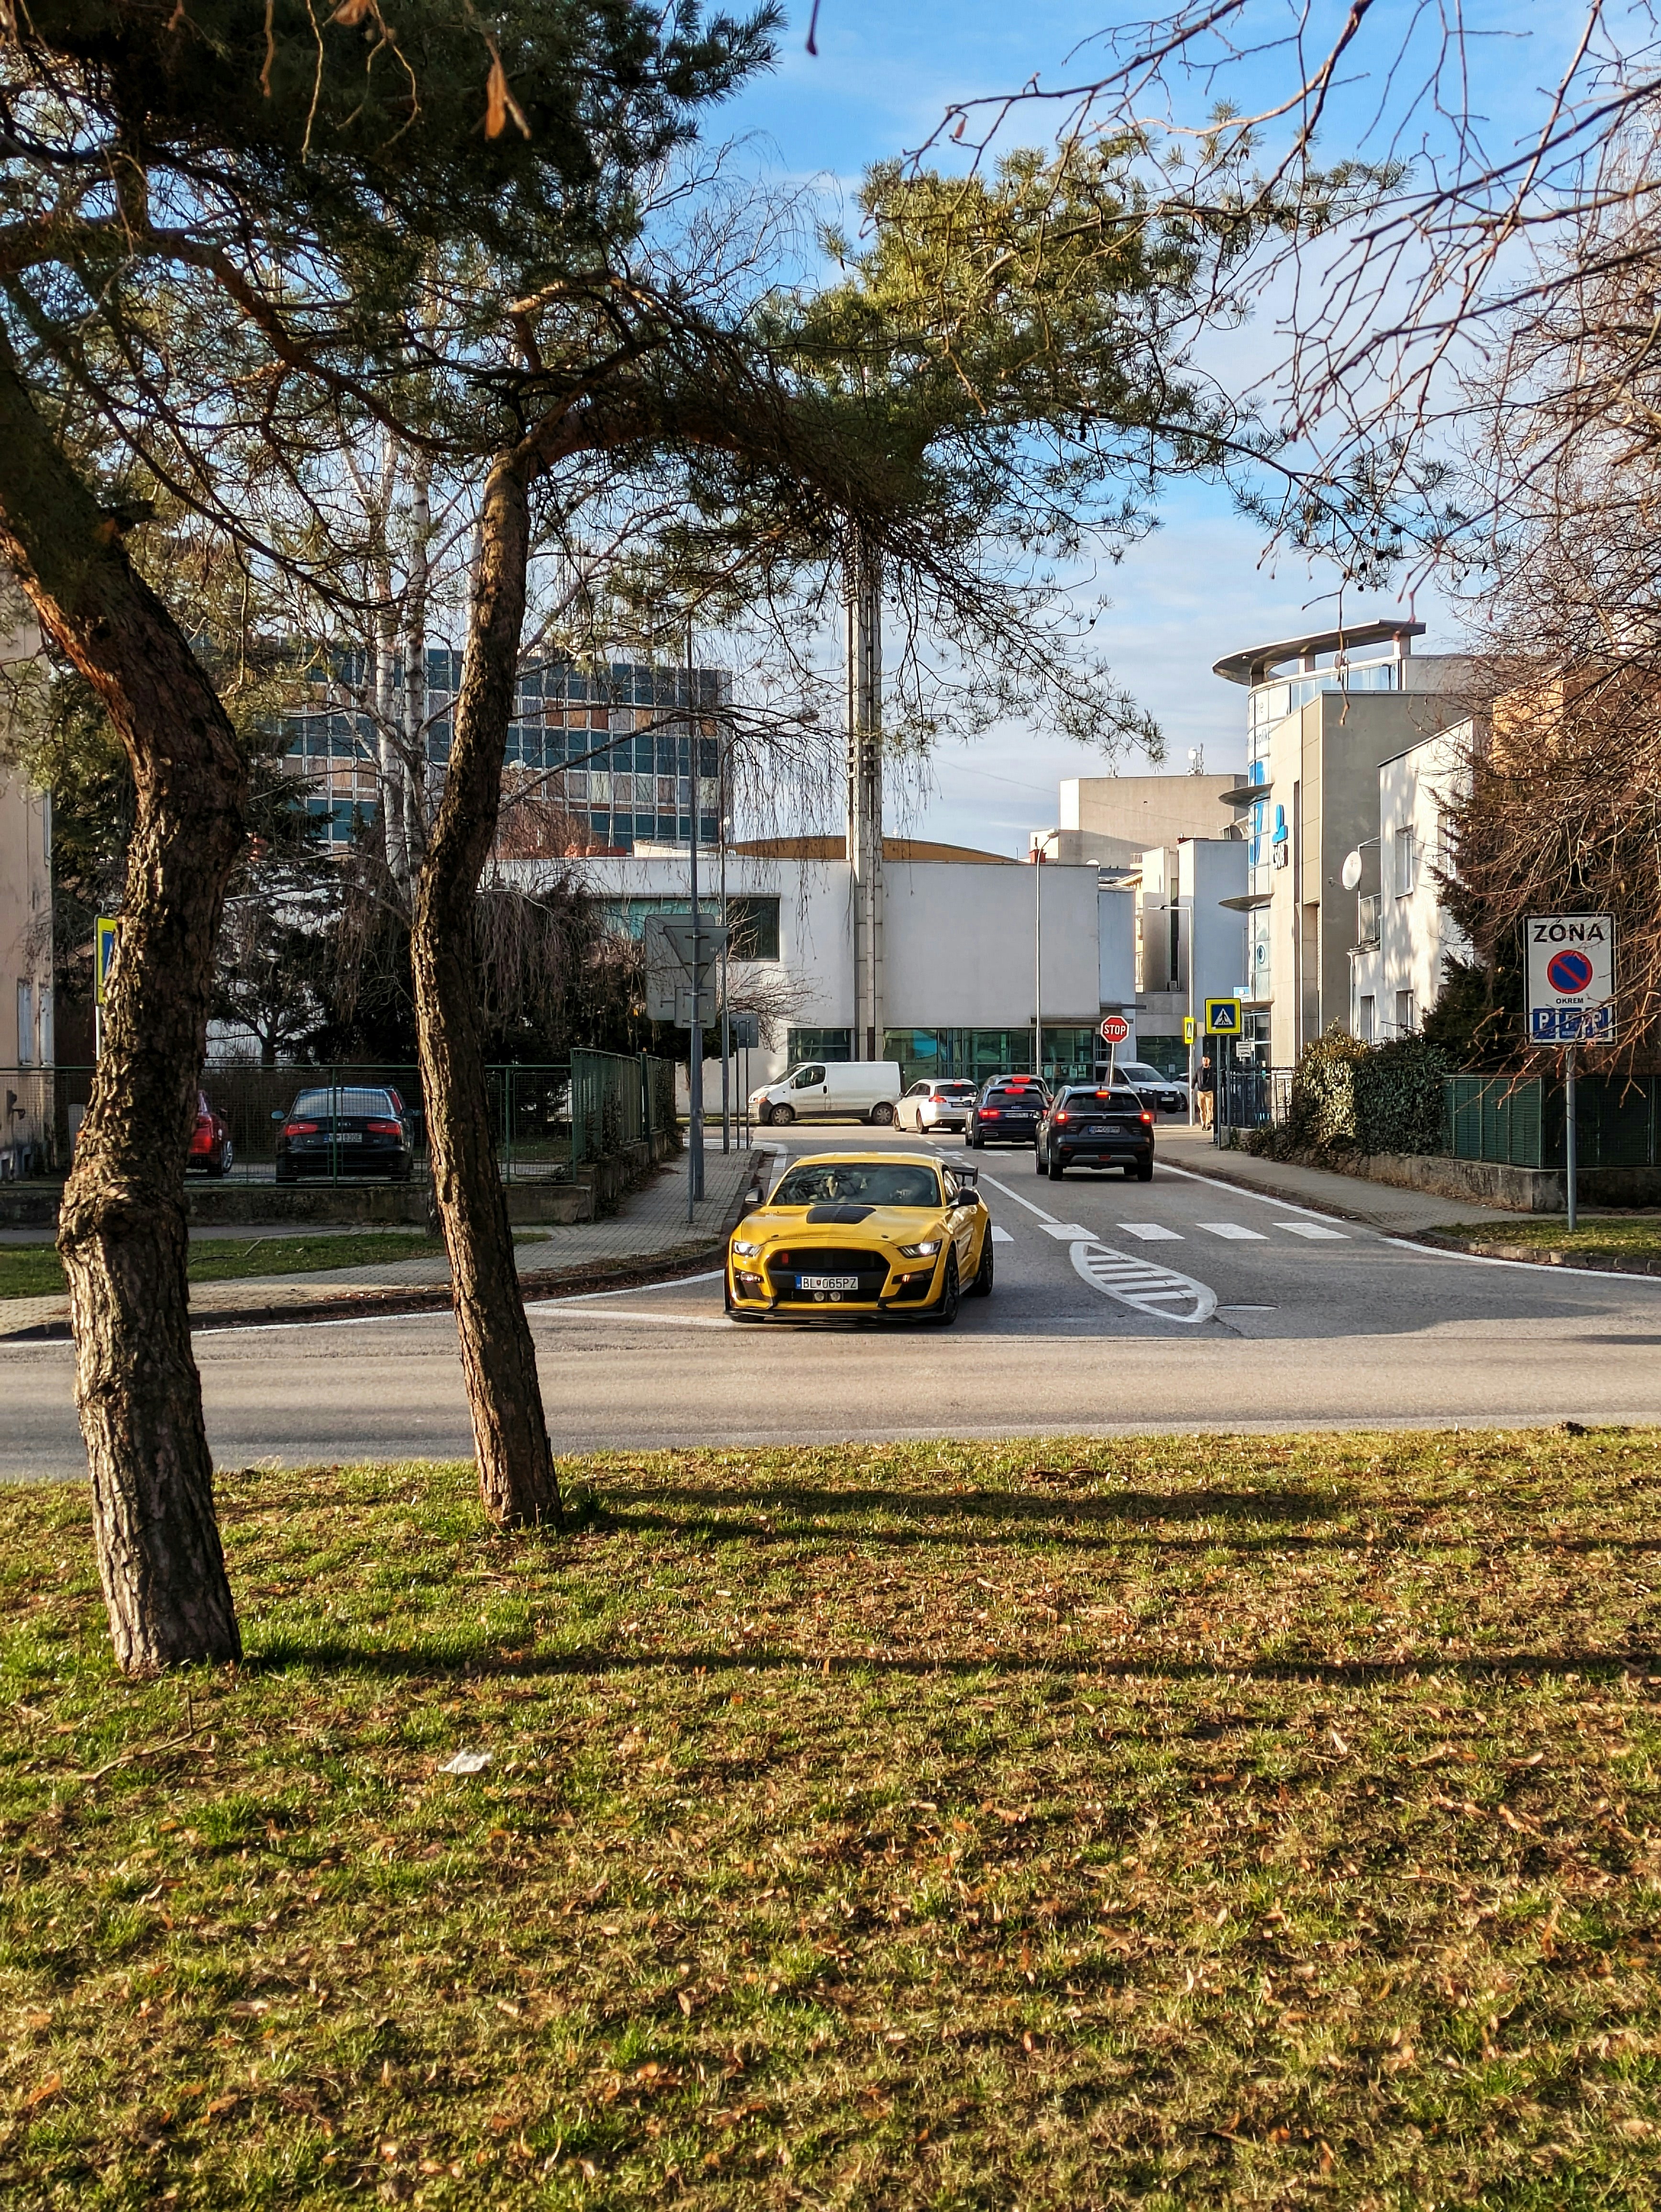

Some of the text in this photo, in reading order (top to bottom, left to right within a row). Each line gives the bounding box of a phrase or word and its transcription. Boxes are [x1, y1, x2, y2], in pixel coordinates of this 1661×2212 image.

[1534, 919, 1604, 942] ZÓNA
[1539, 1012, 1549, 1029] P
[1104, 1024, 1126, 1035] STOP
